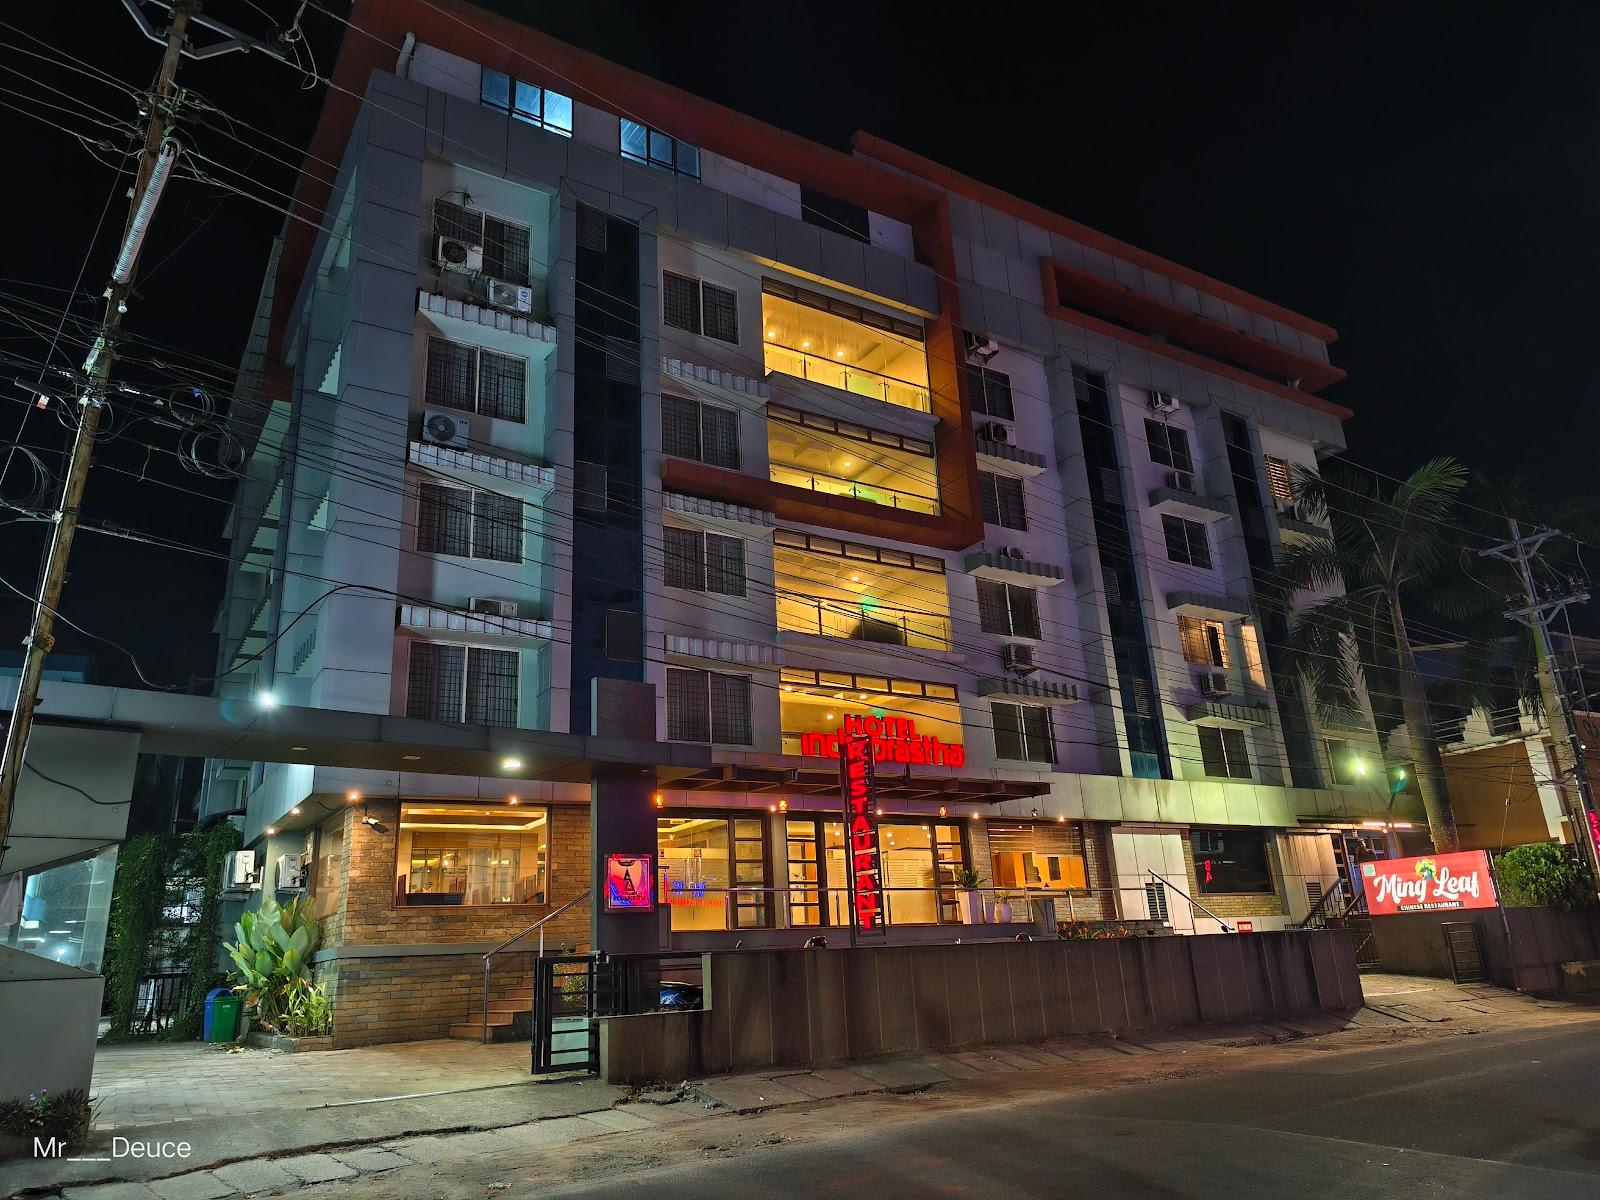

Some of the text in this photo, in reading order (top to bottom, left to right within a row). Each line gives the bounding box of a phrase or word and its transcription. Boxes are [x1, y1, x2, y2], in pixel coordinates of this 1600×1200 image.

[844, 714, 921, 740] HOTEL
[801, 728, 965, 768] indprastha
[849, 740, 876, 929] RESTAURANT
[1373, 867, 1480, 904] Ming Leaf
[1424, 901, 1460, 909] RESTAURANT
